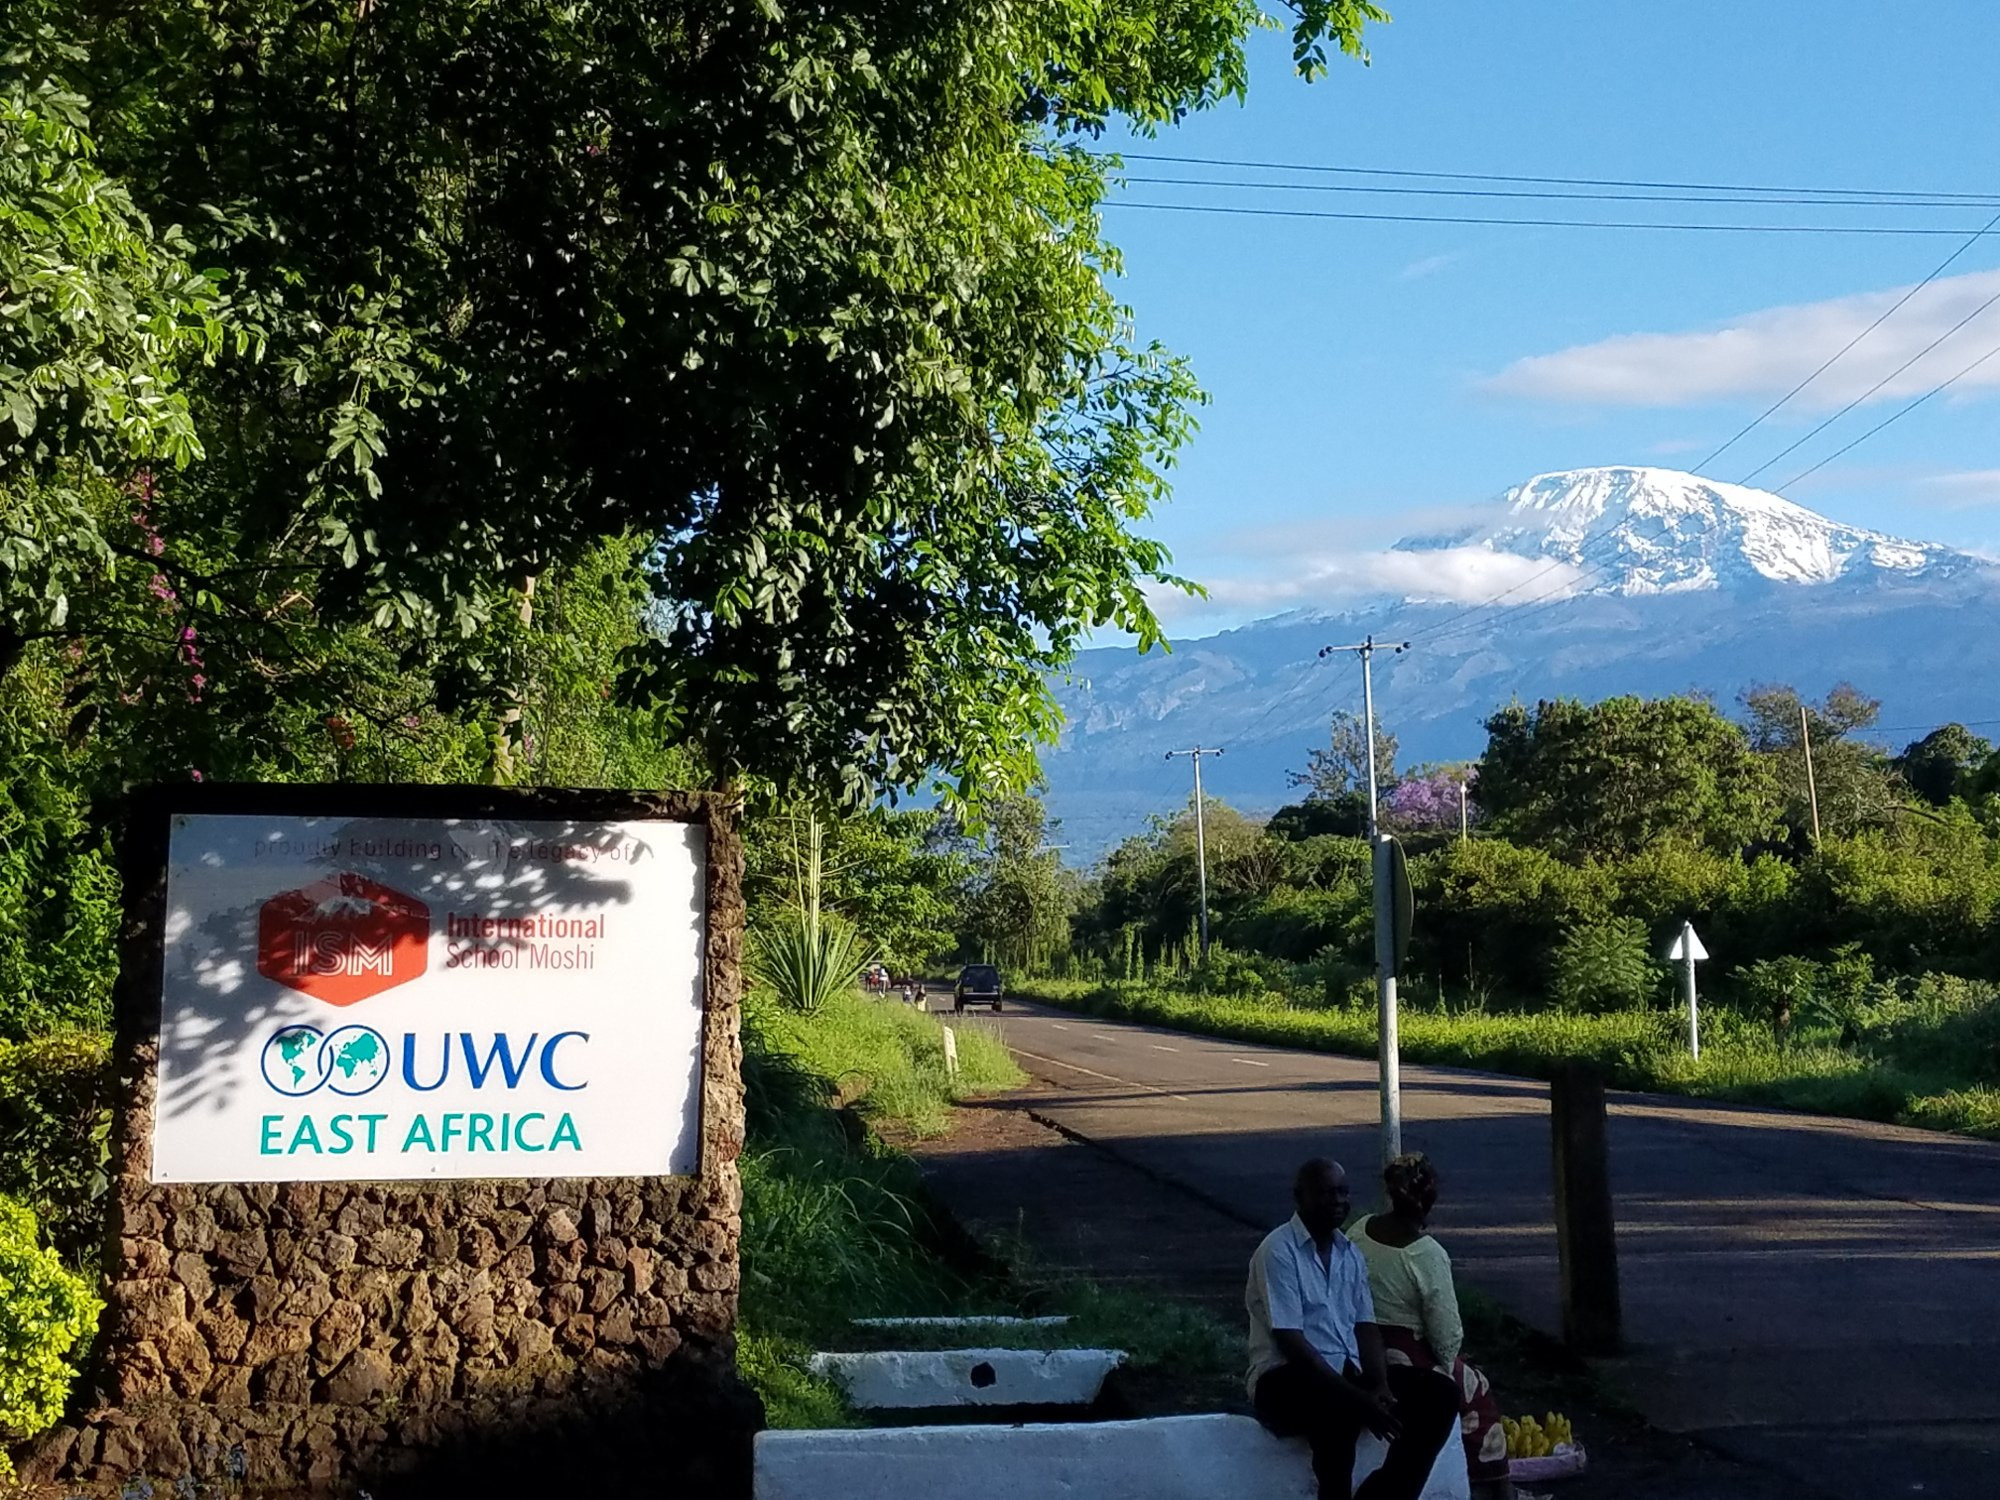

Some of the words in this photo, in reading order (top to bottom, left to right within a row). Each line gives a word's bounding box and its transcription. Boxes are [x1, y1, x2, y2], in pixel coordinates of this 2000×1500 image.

[350, 838, 441, 861] building
[530, 840, 600, 863] legacy
[610, 842, 631, 860] of
[447, 911, 605, 939] International
[291, 930, 393, 976] ISM
[446, 942, 521, 970] School
[529, 942, 595, 970] Moshi
[402, 1032, 590, 1091] UWC
[260, 1114, 389, 1155] EAST
[400, 1112, 583, 1152] AFRICA
